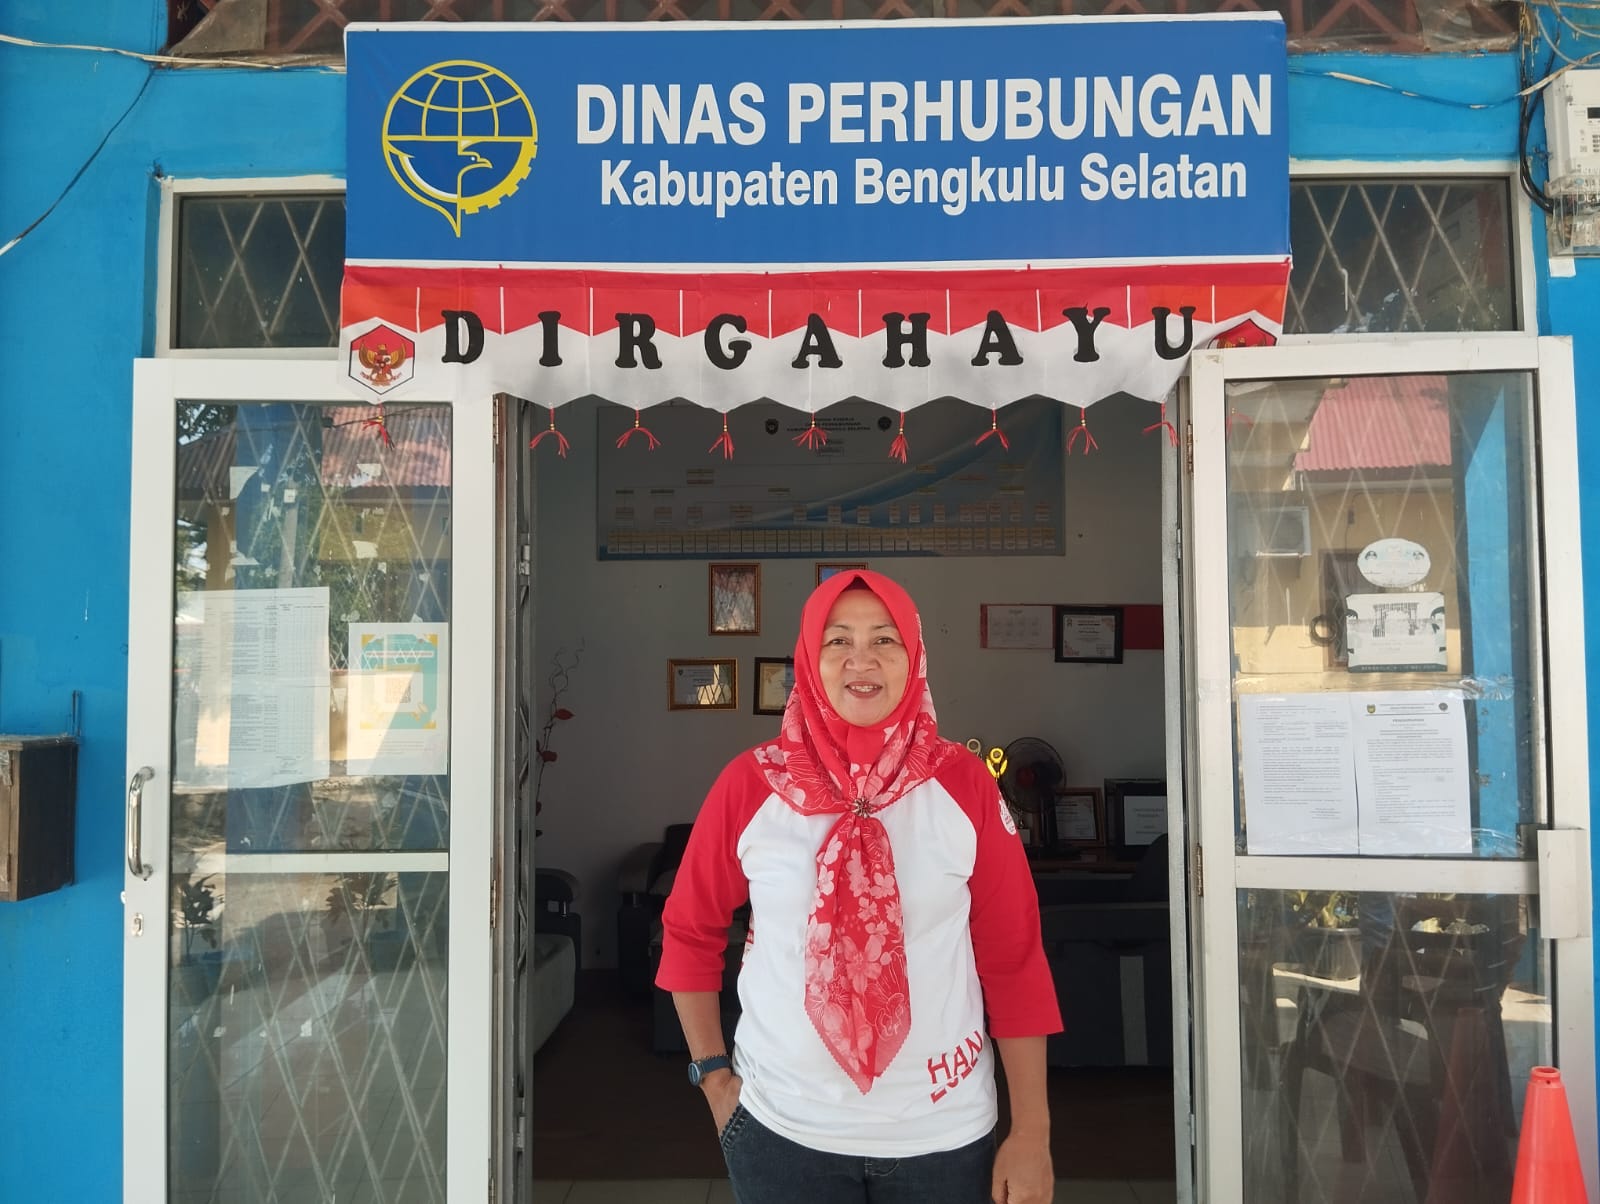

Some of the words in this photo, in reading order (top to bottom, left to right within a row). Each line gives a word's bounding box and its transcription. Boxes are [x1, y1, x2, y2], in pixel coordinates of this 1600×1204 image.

[577, 83, 766, 146] DINAS
[788, 73, 1272, 144] PERHUBUNGAN
[601, 160, 839, 219] Kabupaten
[855, 154, 1064, 216] Bengkulu
[1080, 152, 1247, 201] Selatan
[441, 307, 1196, 371] DIRGAHAYU
